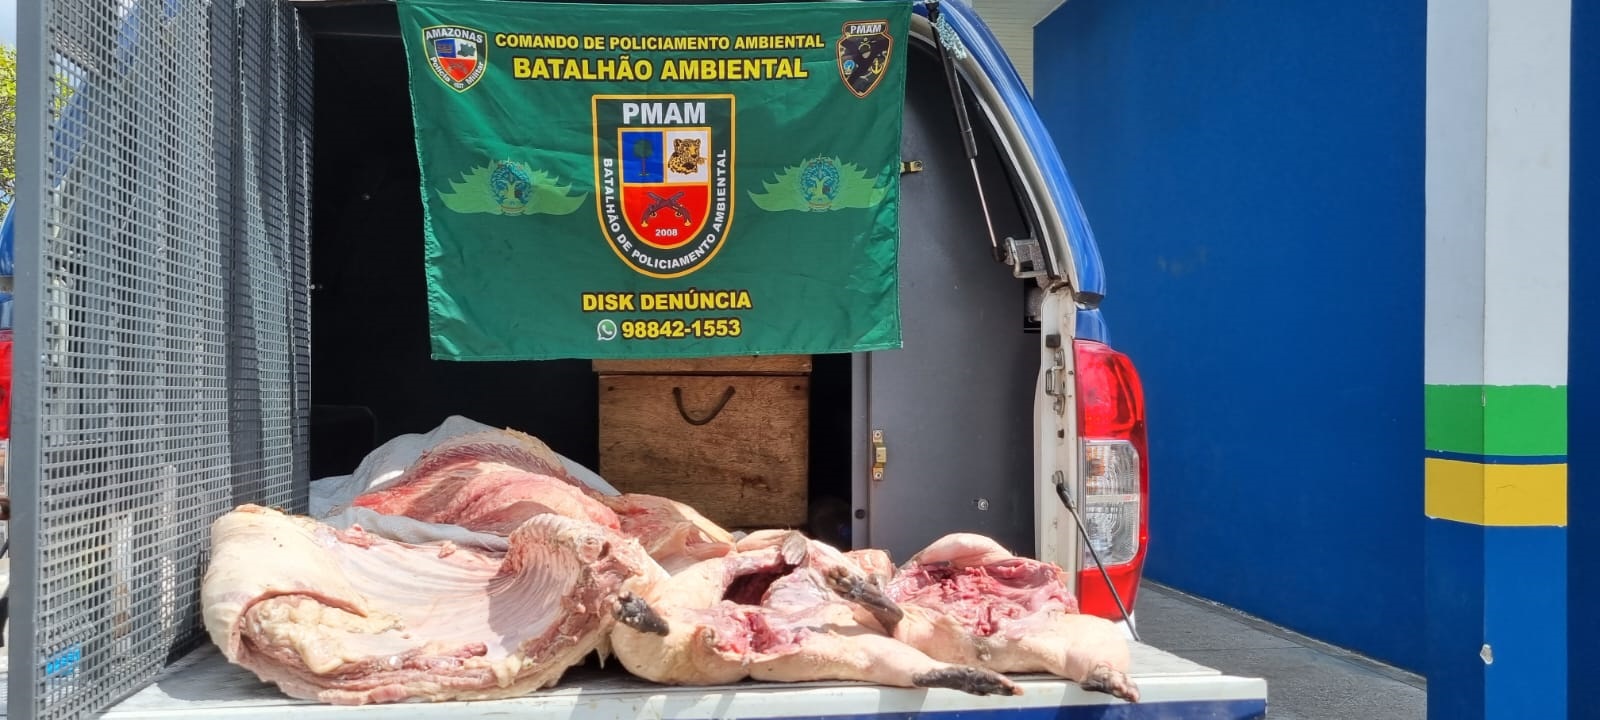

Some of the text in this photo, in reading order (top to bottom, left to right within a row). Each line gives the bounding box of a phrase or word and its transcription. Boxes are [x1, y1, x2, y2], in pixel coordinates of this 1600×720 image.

[426, 28, 483, 43] AMAZONAS
[850, 24, 882, 34] PMAM
[495, 33, 825, 50] COMANDO DE POLICIAMENTO AMBIENTAL
[513, 56, 808, 80] BATALHÃO AMBIENTAL
[622, 102, 706, 125] PMAM
[603, 150, 727, 269] BATALHÃO DE POLICIAMENTO AMBIENTAL
[655, 229, 678, 237] 2008
[583, 289, 752, 311] DISK DENÚNCIA
[621, 319, 741, 338] 98842-1553
